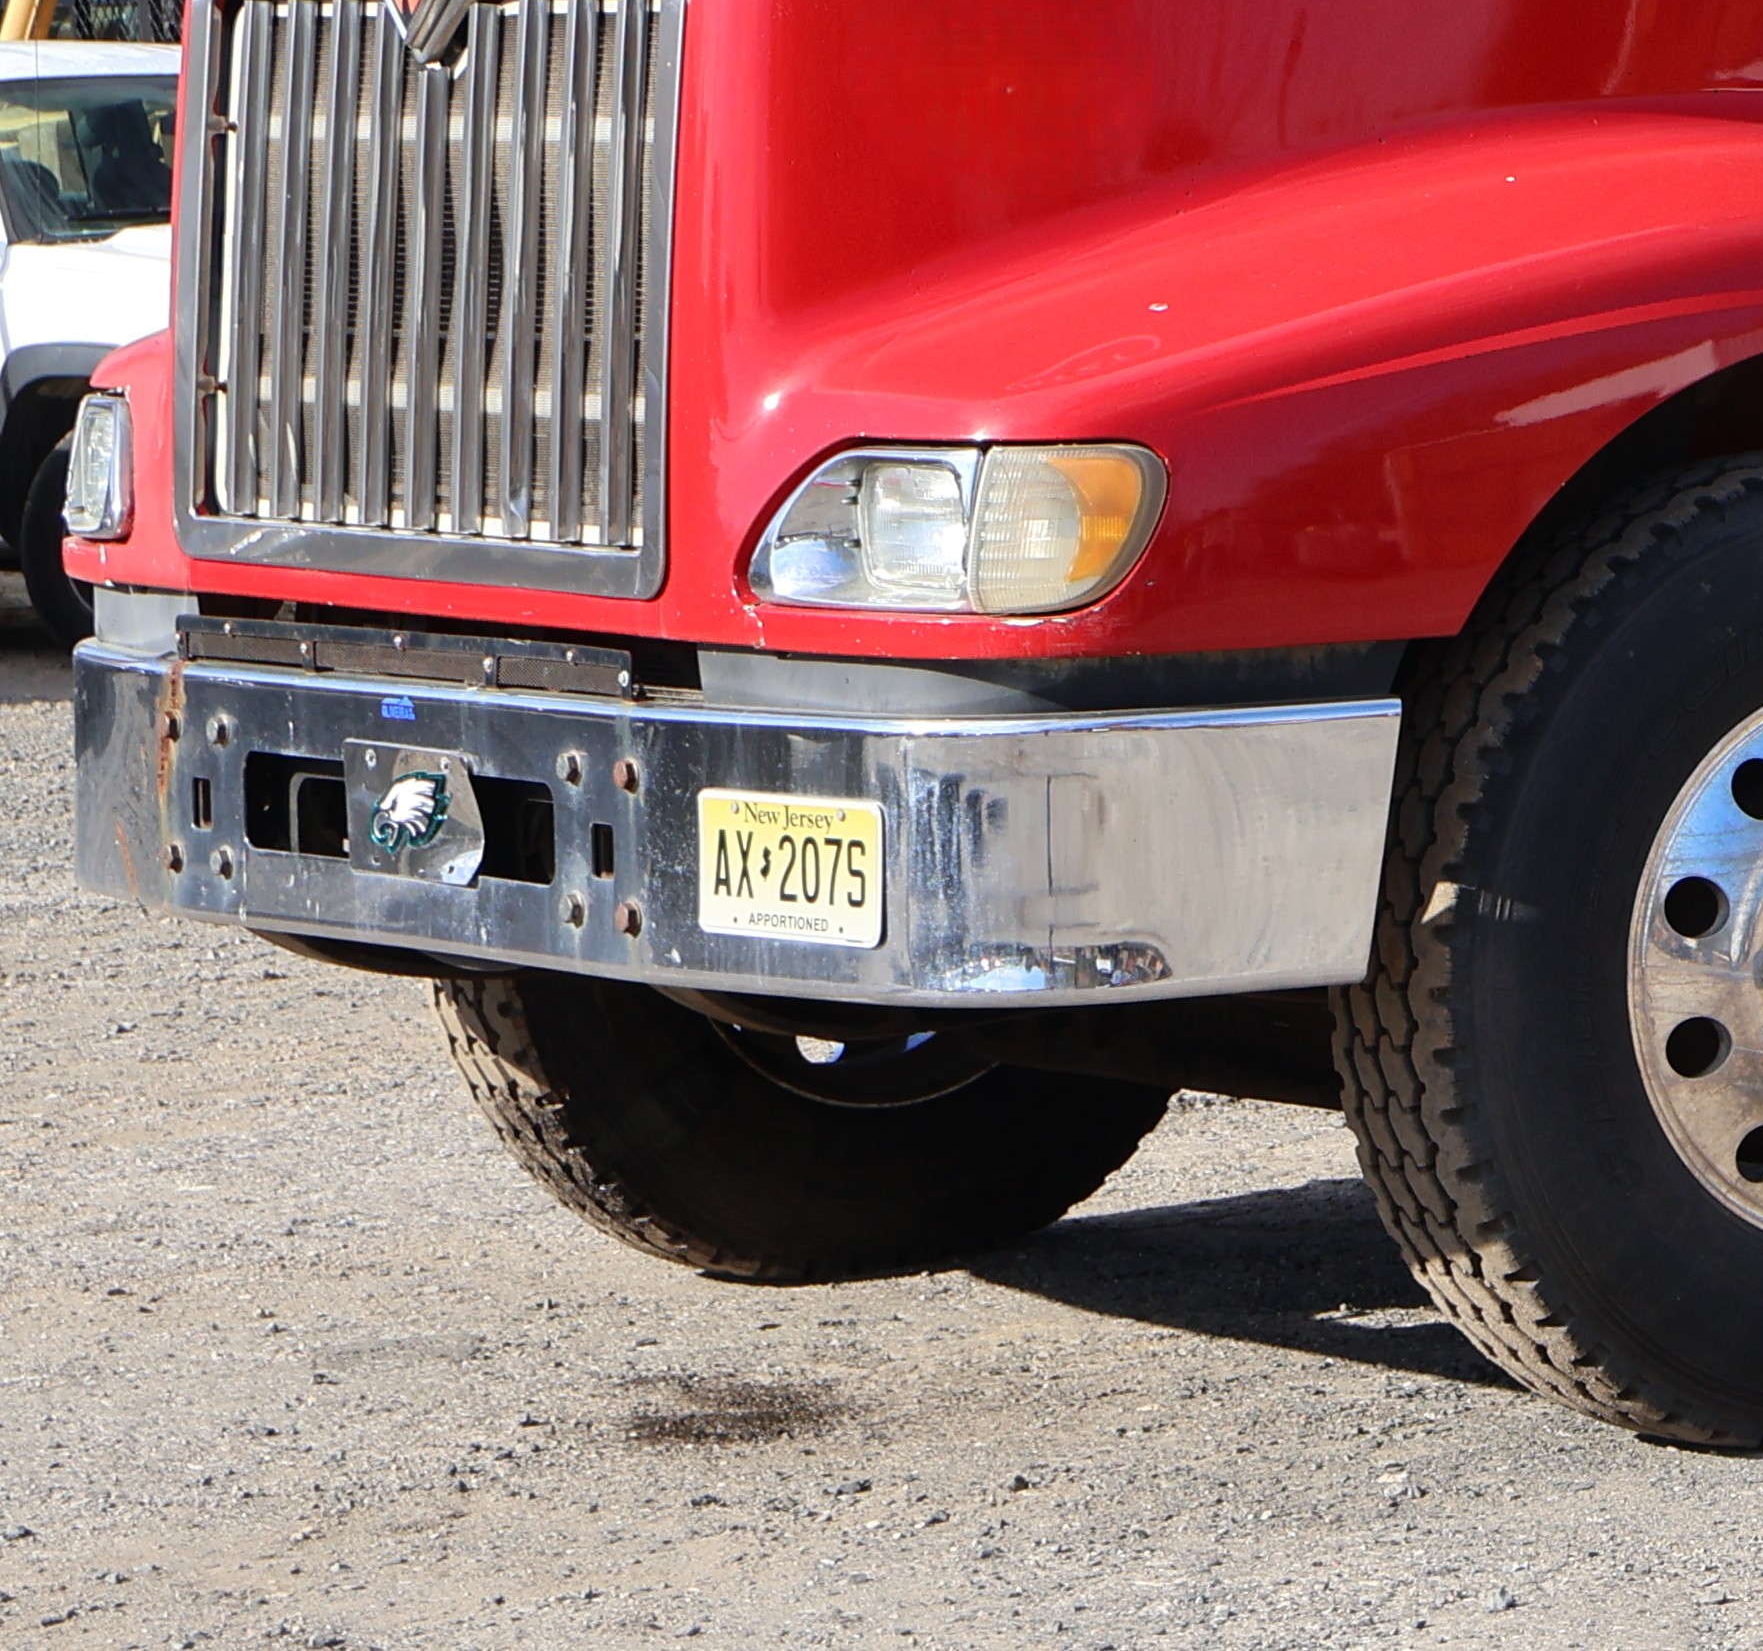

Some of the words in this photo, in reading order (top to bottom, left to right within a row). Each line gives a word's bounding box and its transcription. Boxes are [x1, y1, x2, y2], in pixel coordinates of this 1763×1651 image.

[743, 801, 781, 824] New
[782, 805, 835, 834] Jersey
[713, 829, 754, 899] AX
[748, 912, 829, 932] APPORTIONED
